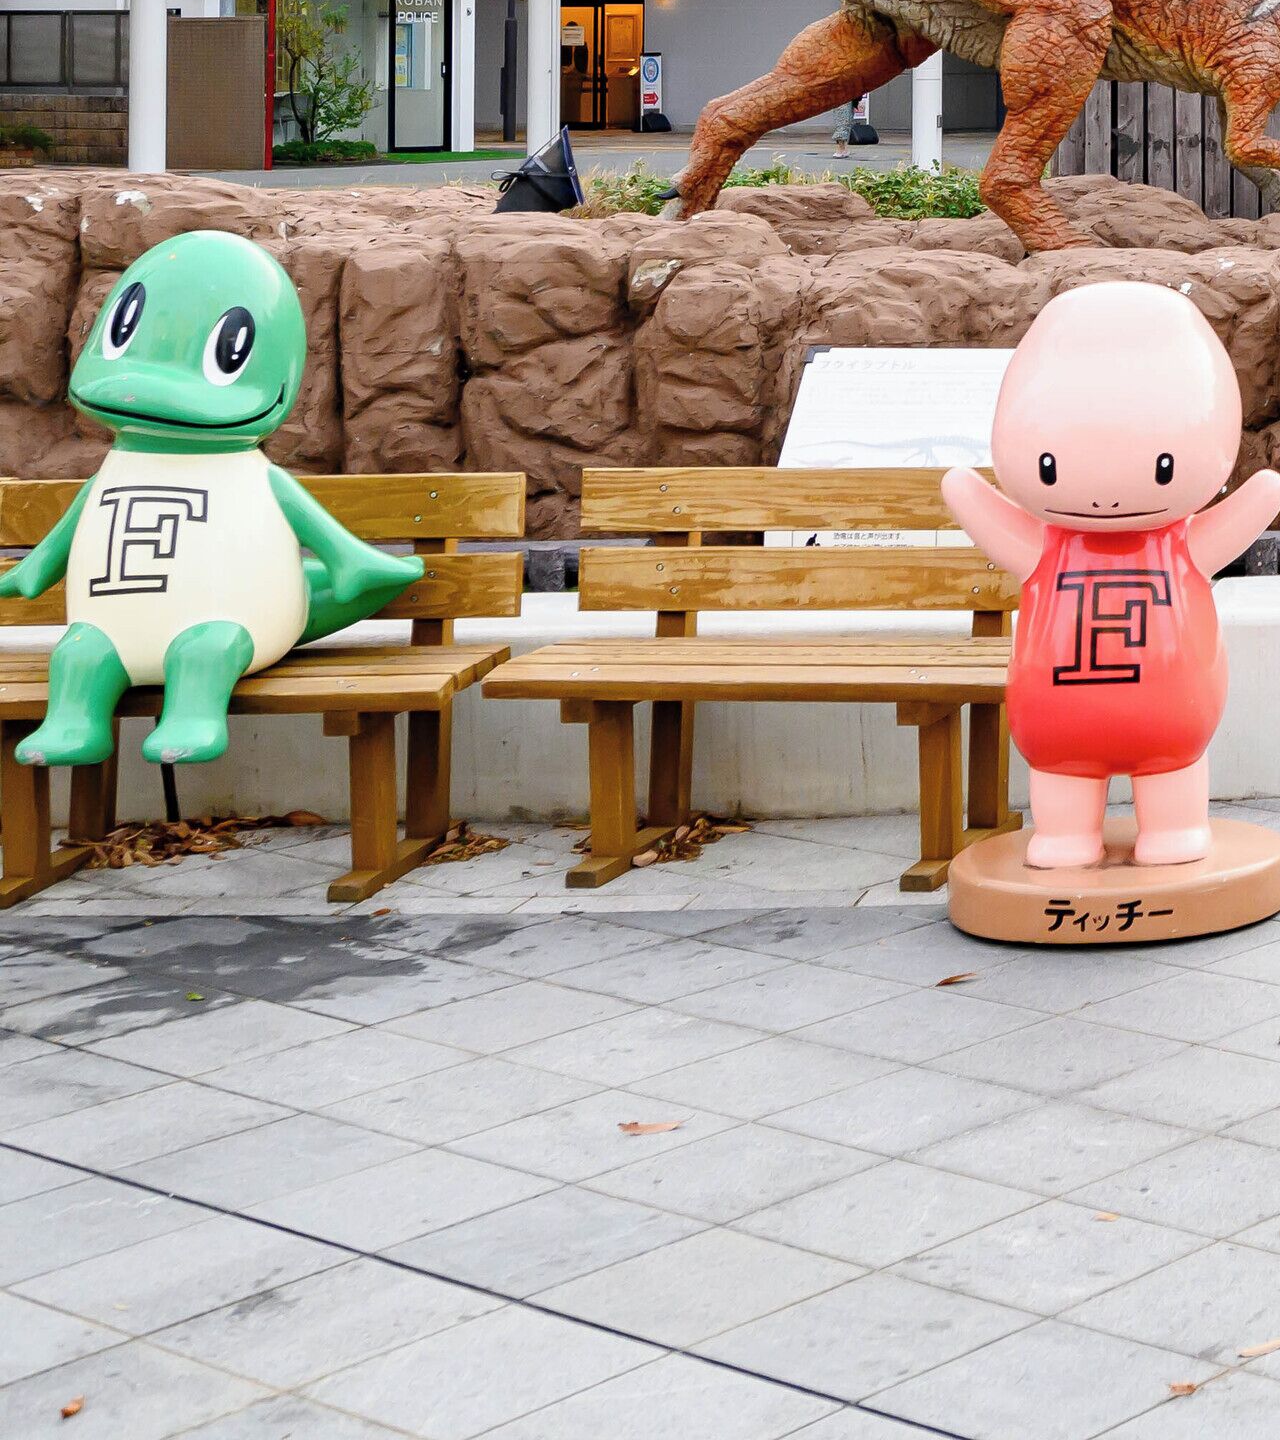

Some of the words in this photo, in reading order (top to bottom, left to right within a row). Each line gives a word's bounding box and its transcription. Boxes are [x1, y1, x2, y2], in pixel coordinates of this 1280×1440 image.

[397, 11, 439, 23] POLICE
[89, 485, 209, 597] F
[1052, 568, 1172, 686] F
[1044, 899, 1174, 932] ティッチー
